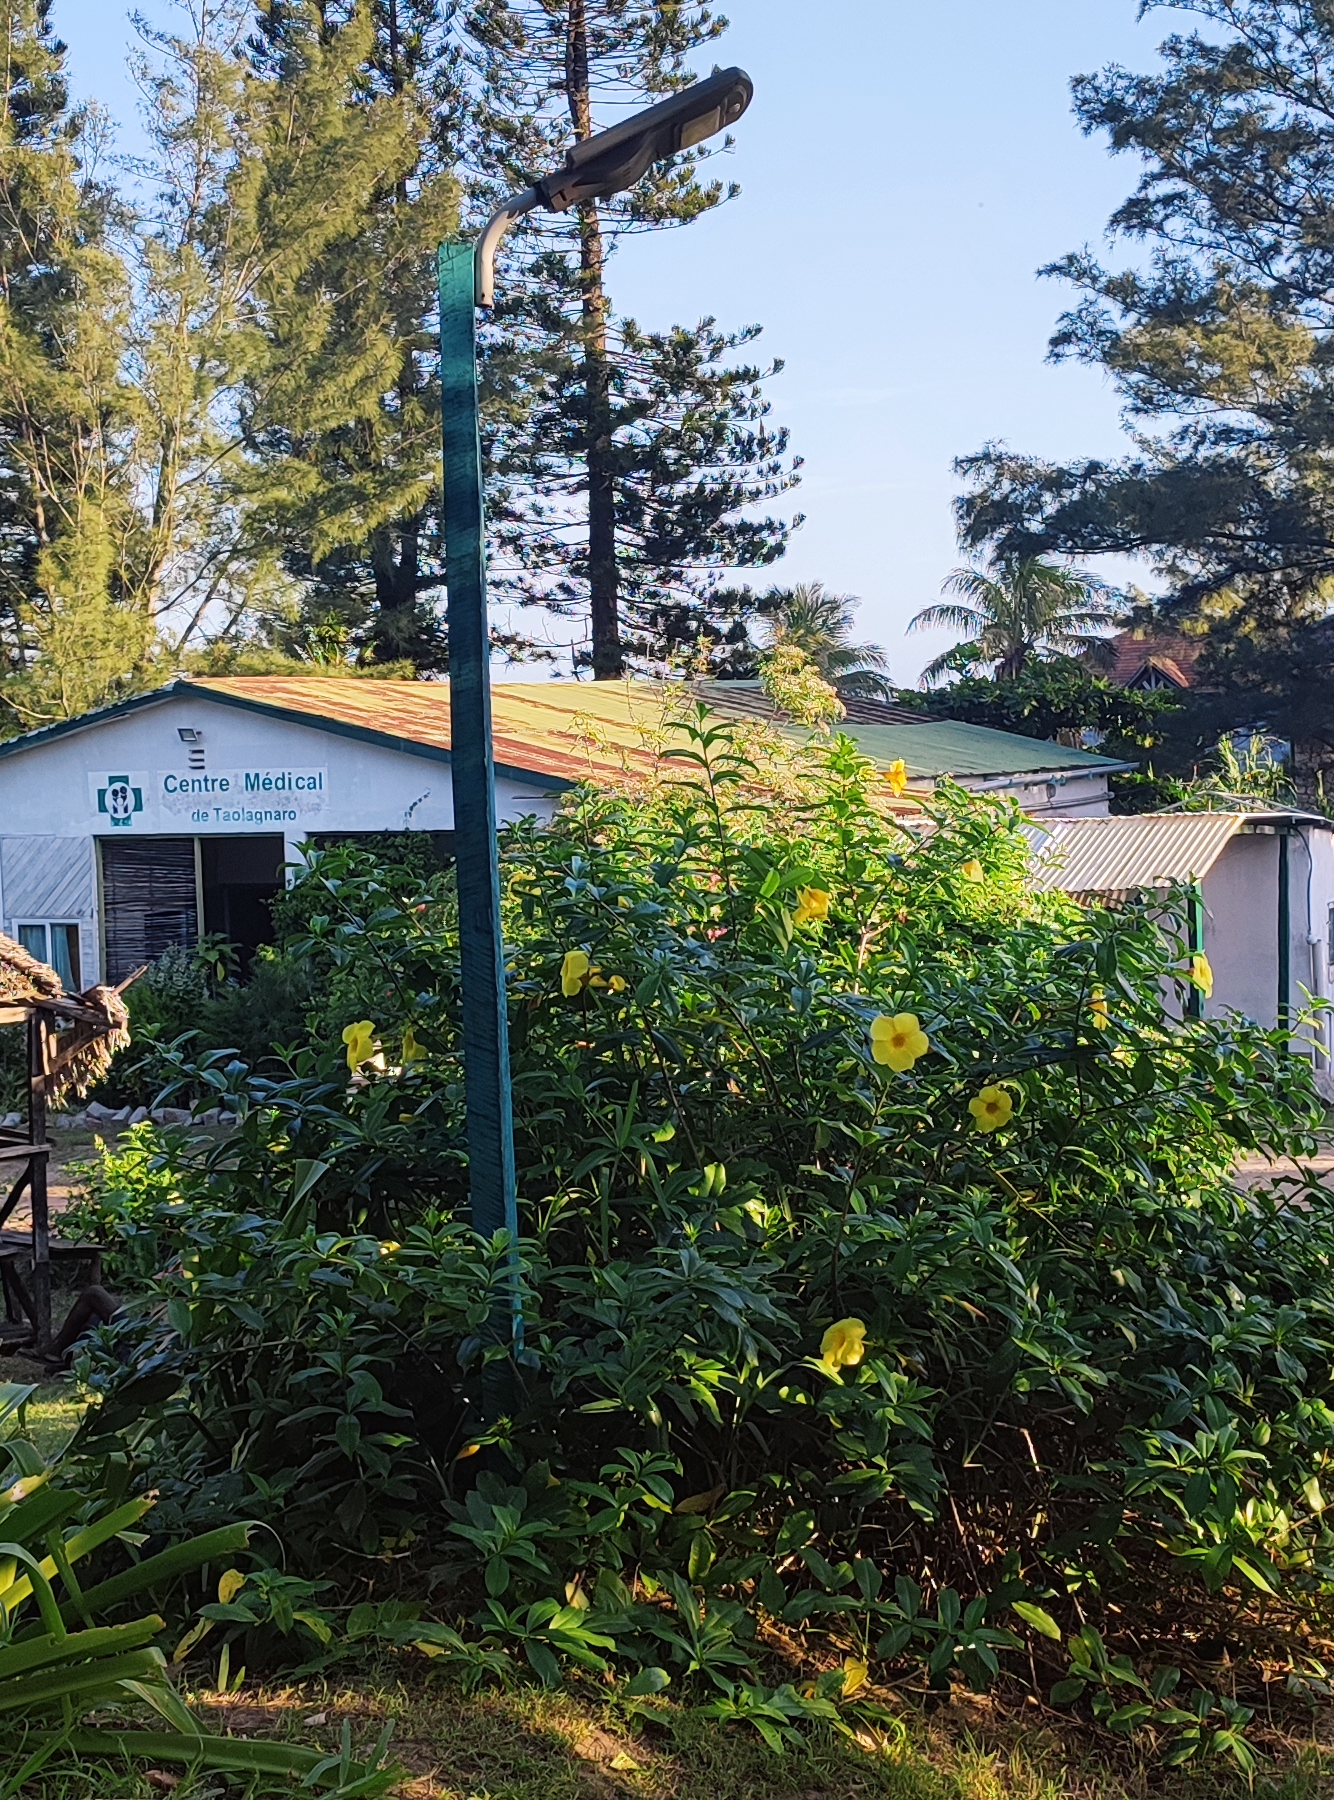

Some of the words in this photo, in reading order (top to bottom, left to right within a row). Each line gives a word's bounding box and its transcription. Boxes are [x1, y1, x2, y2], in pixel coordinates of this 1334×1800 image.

[163, 774, 230, 793] Centre
[244, 772, 323, 791] Médical
[191, 809, 209, 822] de
[213, 807, 297, 825] Taolagnaro
